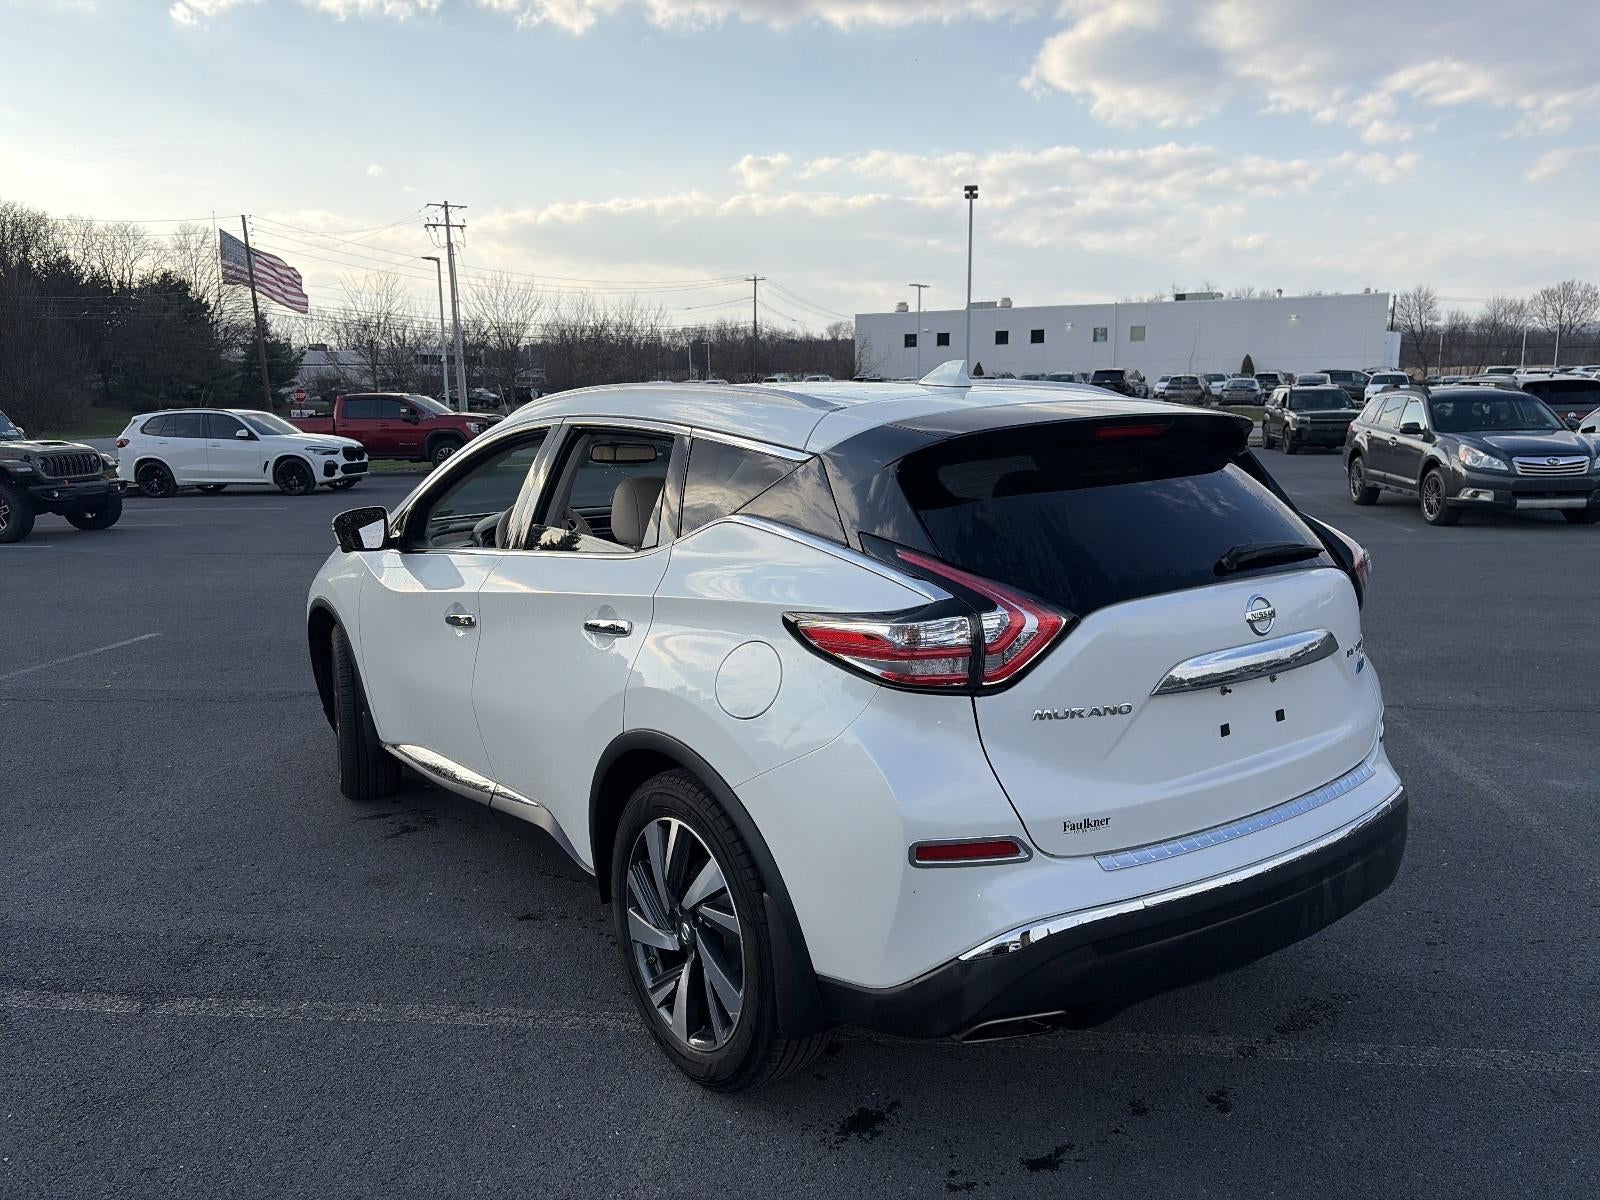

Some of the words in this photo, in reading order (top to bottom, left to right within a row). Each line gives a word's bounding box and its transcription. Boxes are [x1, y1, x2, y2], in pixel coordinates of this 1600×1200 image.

[1250, 608, 1275, 620] NISSAN
[1031, 702, 1133, 721] MURANO
[1062, 817, 1111, 832] Faulkner
